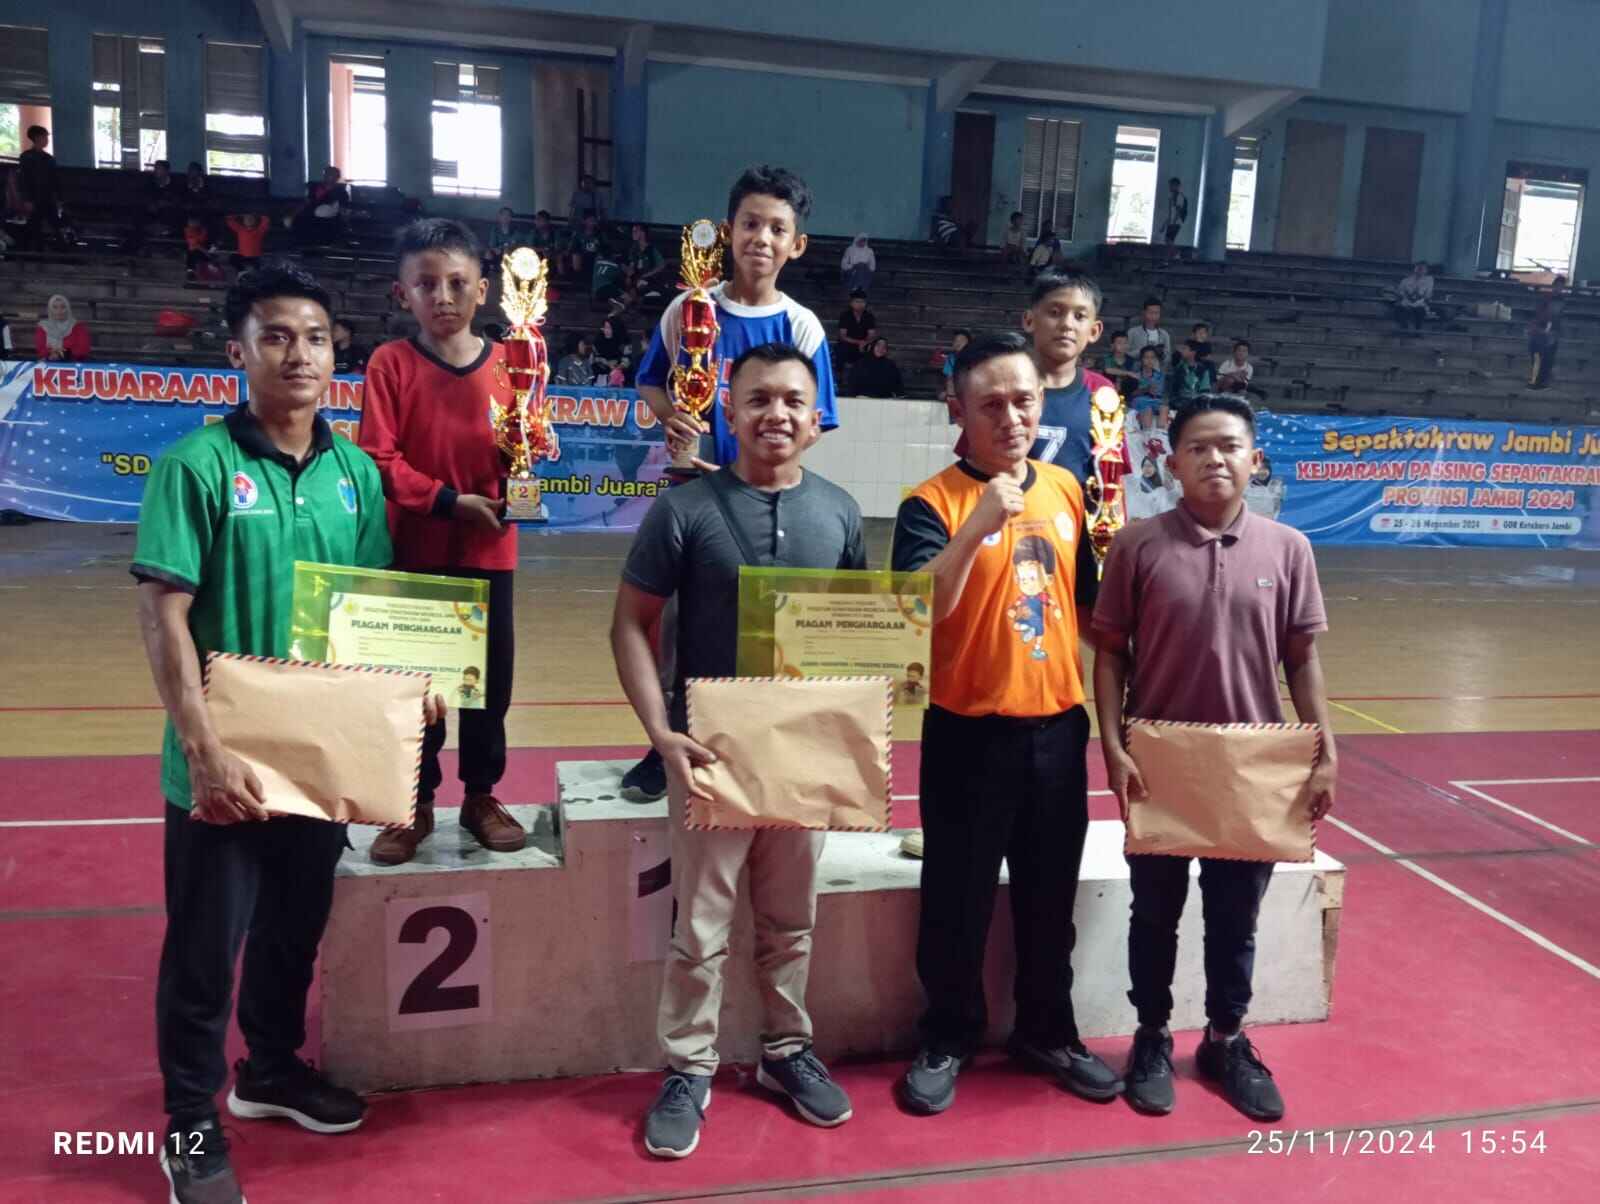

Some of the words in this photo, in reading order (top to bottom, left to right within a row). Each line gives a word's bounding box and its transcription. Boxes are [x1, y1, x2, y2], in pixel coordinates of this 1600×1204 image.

[32, 367, 239, 405] KEJUARAAN
[1322, 426, 1495, 456] Sepaktakraw
[1501, 430, 1573, 454] Jambi
[1295, 460, 1405, 481] KEJUARAAN
[1409, 461, 1486, 482] PASSING
[518, 485, 529, 499] 2
[537, 475, 592, 495] ambi
[1382, 487, 1468, 506] PROVINSI
[1471, 488, 1523, 509] JAMBI
[1526, 490, 1574, 509] 2024
[1393, 518, 1403, 528] 25
[1462, 520, 1480, 529] 2024
[1551, 523, 1572, 531] Jambi
[351, 619, 389, 631] PIAGAM
[392, 623, 462, 635] PENGHARGAAN
[795, 619, 833, 629] PIAGAM
[836, 620, 906, 630] PENGHARGAAN
[398, 905, 480, 1015] 2
